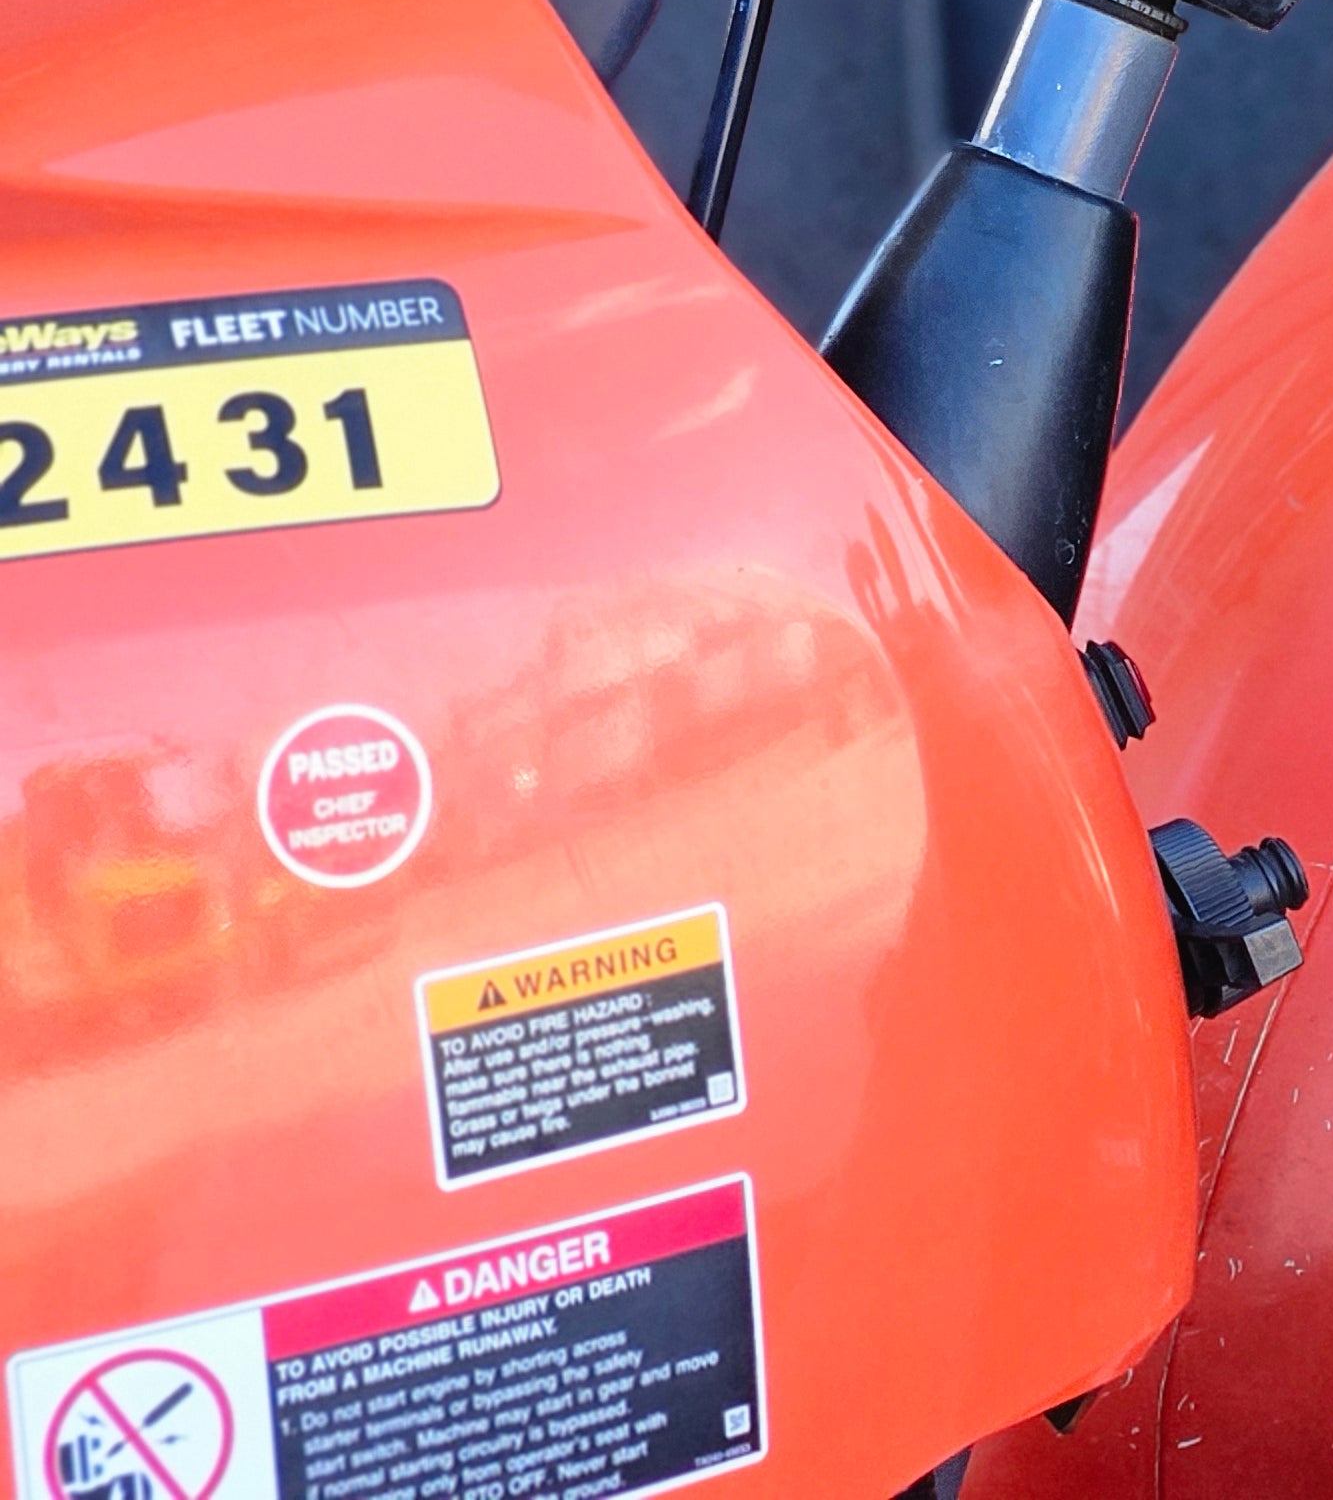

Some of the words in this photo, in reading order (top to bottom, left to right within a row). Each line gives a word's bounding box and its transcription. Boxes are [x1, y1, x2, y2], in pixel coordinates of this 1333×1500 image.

[171, 310, 287, 349] FLEET
[294, 297, 443, 336] NUMBER
[47, 347, 142, 369] RENTALS
[288, 739, 399, 784] PASSED
[288, 813, 407, 850] INSPECTOR
[514, 937, 678, 999] WARNING
[441, 1037, 465, 1057] TO
[471, 1023, 525, 1052] AVOID
[529, 1011, 569, 1035] FIRE
[443, 1055, 481, 1078] After
[485, 1049, 514, 1068] use
[519, 1033, 571, 1059] and/or
[445, 1073, 488, 1098] make
[493, 1065, 527, 1086] sure
[531, 1052, 572, 1078] there
[576, 1047, 591, 1065] is
[594, 1033, 651, 1062] nothing
[450, 1111, 497, 1138] Grass
[501, 1107, 518, 1126] or
[522, 1096, 564, 1125] twigs
[567, 1084, 611, 1108] under
[615, 1077, 640, 1095] the
[643, 1061, 696, 1088] bonnet
[531, 1075, 567, 1096] near
[570, 1067, 596, 1087] the
[600, 1050, 659, 1080] exhaust
[452, 1133, 487, 1158] may
[490, 1124, 538, 1148] cause
[444, 1231, 611, 1305] DANGER
[275, 1362, 305, 1383] TO
[311, 1341, 374, 1374] AVOID
[379, 1315, 476, 1360] POSSIBLE
[481, 1295, 549, 1328] INJURY
[554, 1286, 584, 1308] OR
[588, 1267, 652, 1300] DEATH
[276, 1379, 337, 1408] FROM
[342, 1370, 358, 1389] A
[363, 1346, 452, 1385] MACHINE
[457, 1316, 558, 1360] RUNAWAY.
[301, 1411, 329, 1432] Do
[333, 1401, 363, 1423] not
[367, 1390, 406, 1414] start
[411, 1374, 470, 1402] engine
[473, 1367, 496, 1388] by
[501, 1346, 568, 1379] shorting
[572, 1329, 627, 1358] across
[304, 1427, 361, 1456] starter
[365, 1405, 446, 1439] terminals
[449, 1398, 468, 1417] or
[472, 1373, 558, 1412] bypassing
[562, 1364, 590, 1385] the
[594, 1348, 644, 1377] safety
[305, 1454, 346, 1481] start
[416, 1417, 490, 1449] Machine
[494, 1405, 531, 1429] may
[535, 1391, 573, 1417] start
[577, 1386, 593, 1404] in
[597, 1375, 635, 1403] gear
[639, 1361, 672, 1387] and
[675, 1350, 719, 1375] move
[323, 1466, 386, 1499] normal
[390, 1451, 454, 1482] starting
[458, 1431, 525, 1462] circuitry
[528, 1424, 544, 1442] is
[420, 1474, 458, 1497] only
[461, 1460, 501, 1484] from
[505, 1435, 591, 1473] operator's
[594, 1422, 631, 1447] seat
[634, 1410, 668, 1434] with
[557, 1454, 608, 1482] Never
[611, 1440, 649, 1466] start
